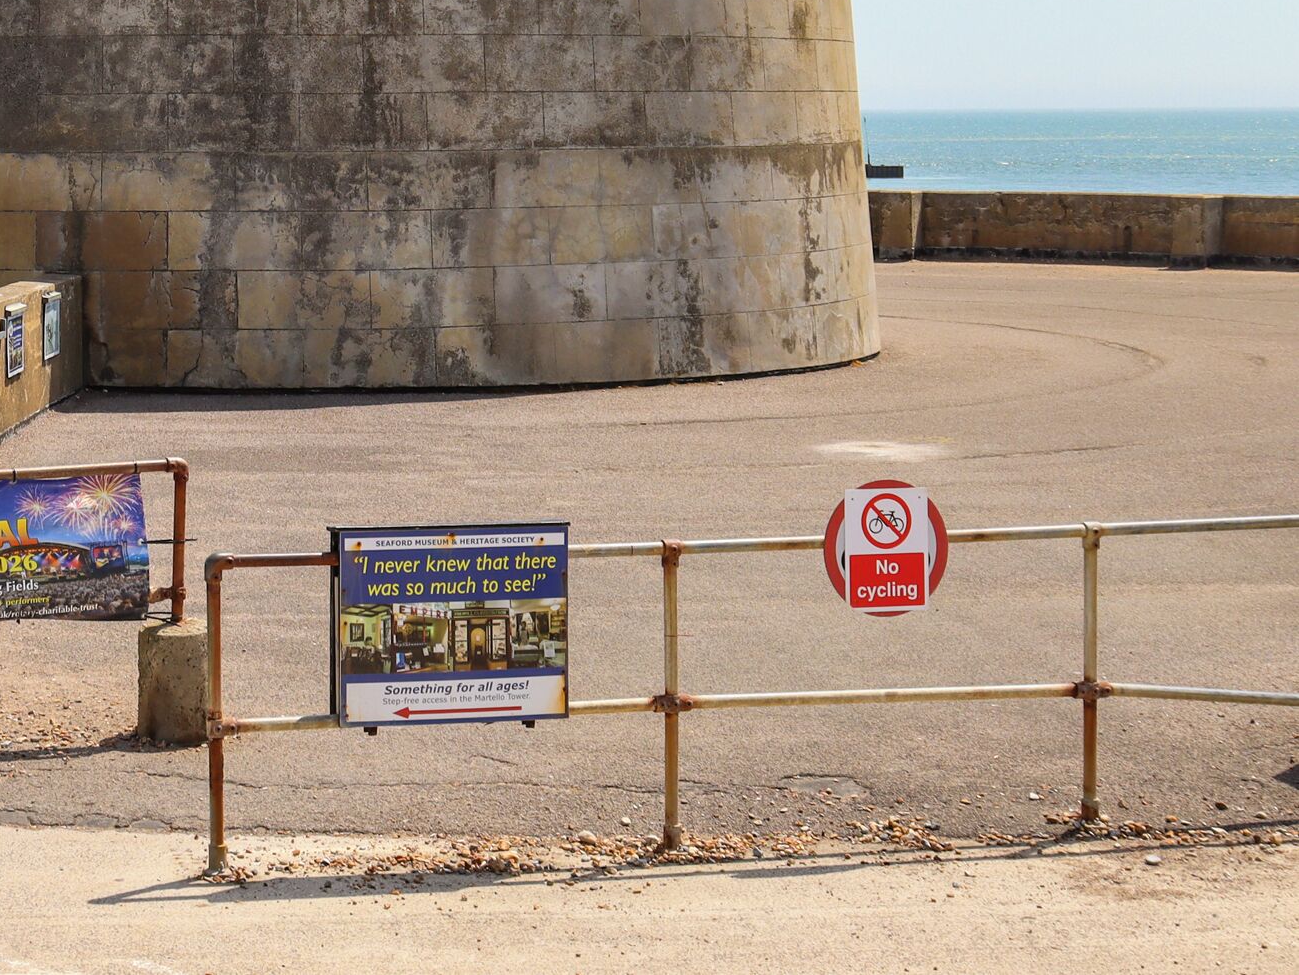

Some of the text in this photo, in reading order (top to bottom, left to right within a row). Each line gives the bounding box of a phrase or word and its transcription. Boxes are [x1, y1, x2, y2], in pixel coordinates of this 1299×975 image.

[375, 536, 535, 547] SEAFORD MUSEUM & HERITAGE SOCIETY
[374, 559, 420, 574] never
[426, 555, 471, 572] knew
[476, 553, 509, 571] that
[514, 552, 556, 570] there
[876, 559, 899, 575] No
[6, 579, 39, 593] Fields
[367, 582, 400, 597] was
[406, 582, 424, 596] so
[429, 576, 477, 594] much
[482, 577, 499, 593] to
[857, 581, 918, 602] cycling
[5, 596, 51, 607] performers
[399, 605, 450, 619] EMPIRE
[384, 680, 529, 695] Something for all ages!
[382, 697, 420, 706] Step-free
[474, 693, 505, 702] Martello
[508, 692, 531, 700] Tower.
